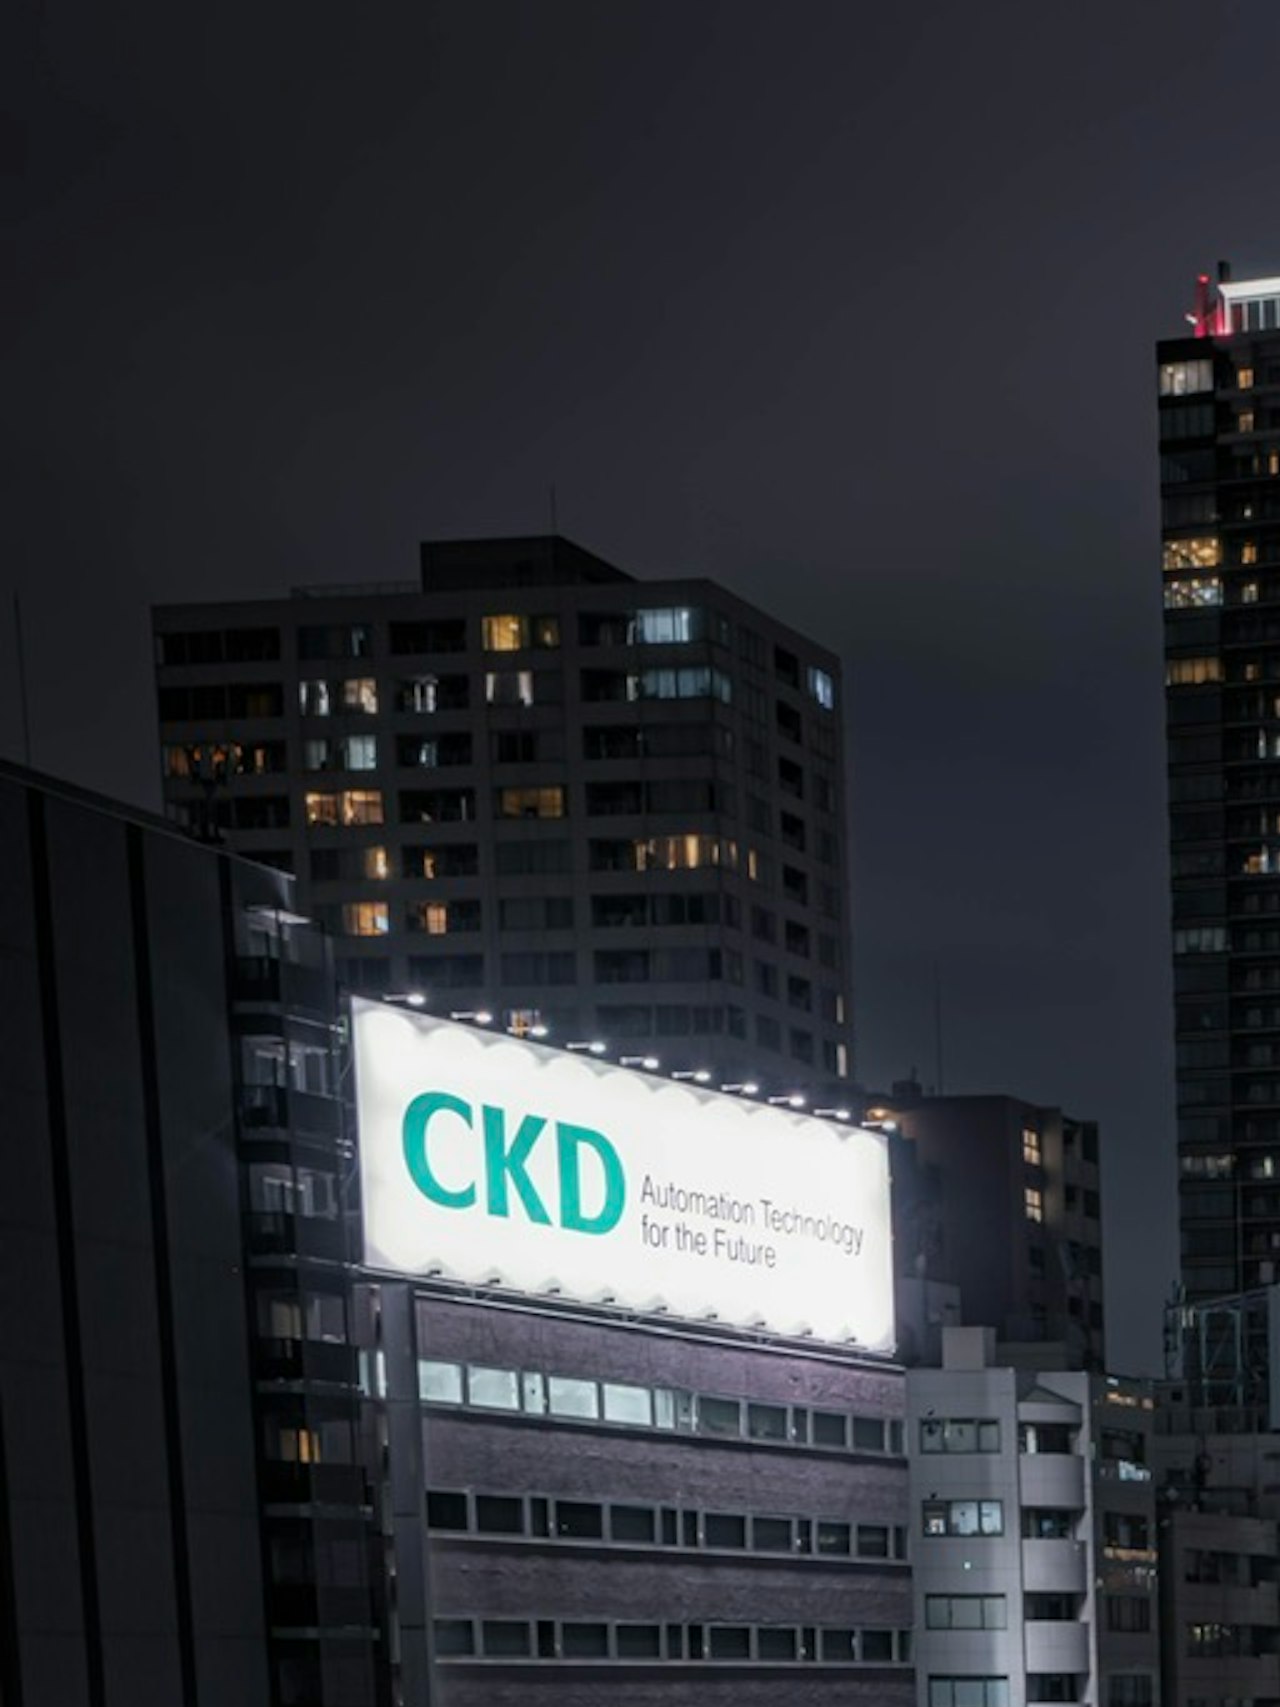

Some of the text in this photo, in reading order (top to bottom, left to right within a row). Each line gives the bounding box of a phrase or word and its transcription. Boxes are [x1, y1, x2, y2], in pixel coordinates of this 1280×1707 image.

[402, 1090, 626, 1235] CKD
[638, 1174, 864, 1256] Automation Technology
[641, 1214, 776, 1268] for the Future
